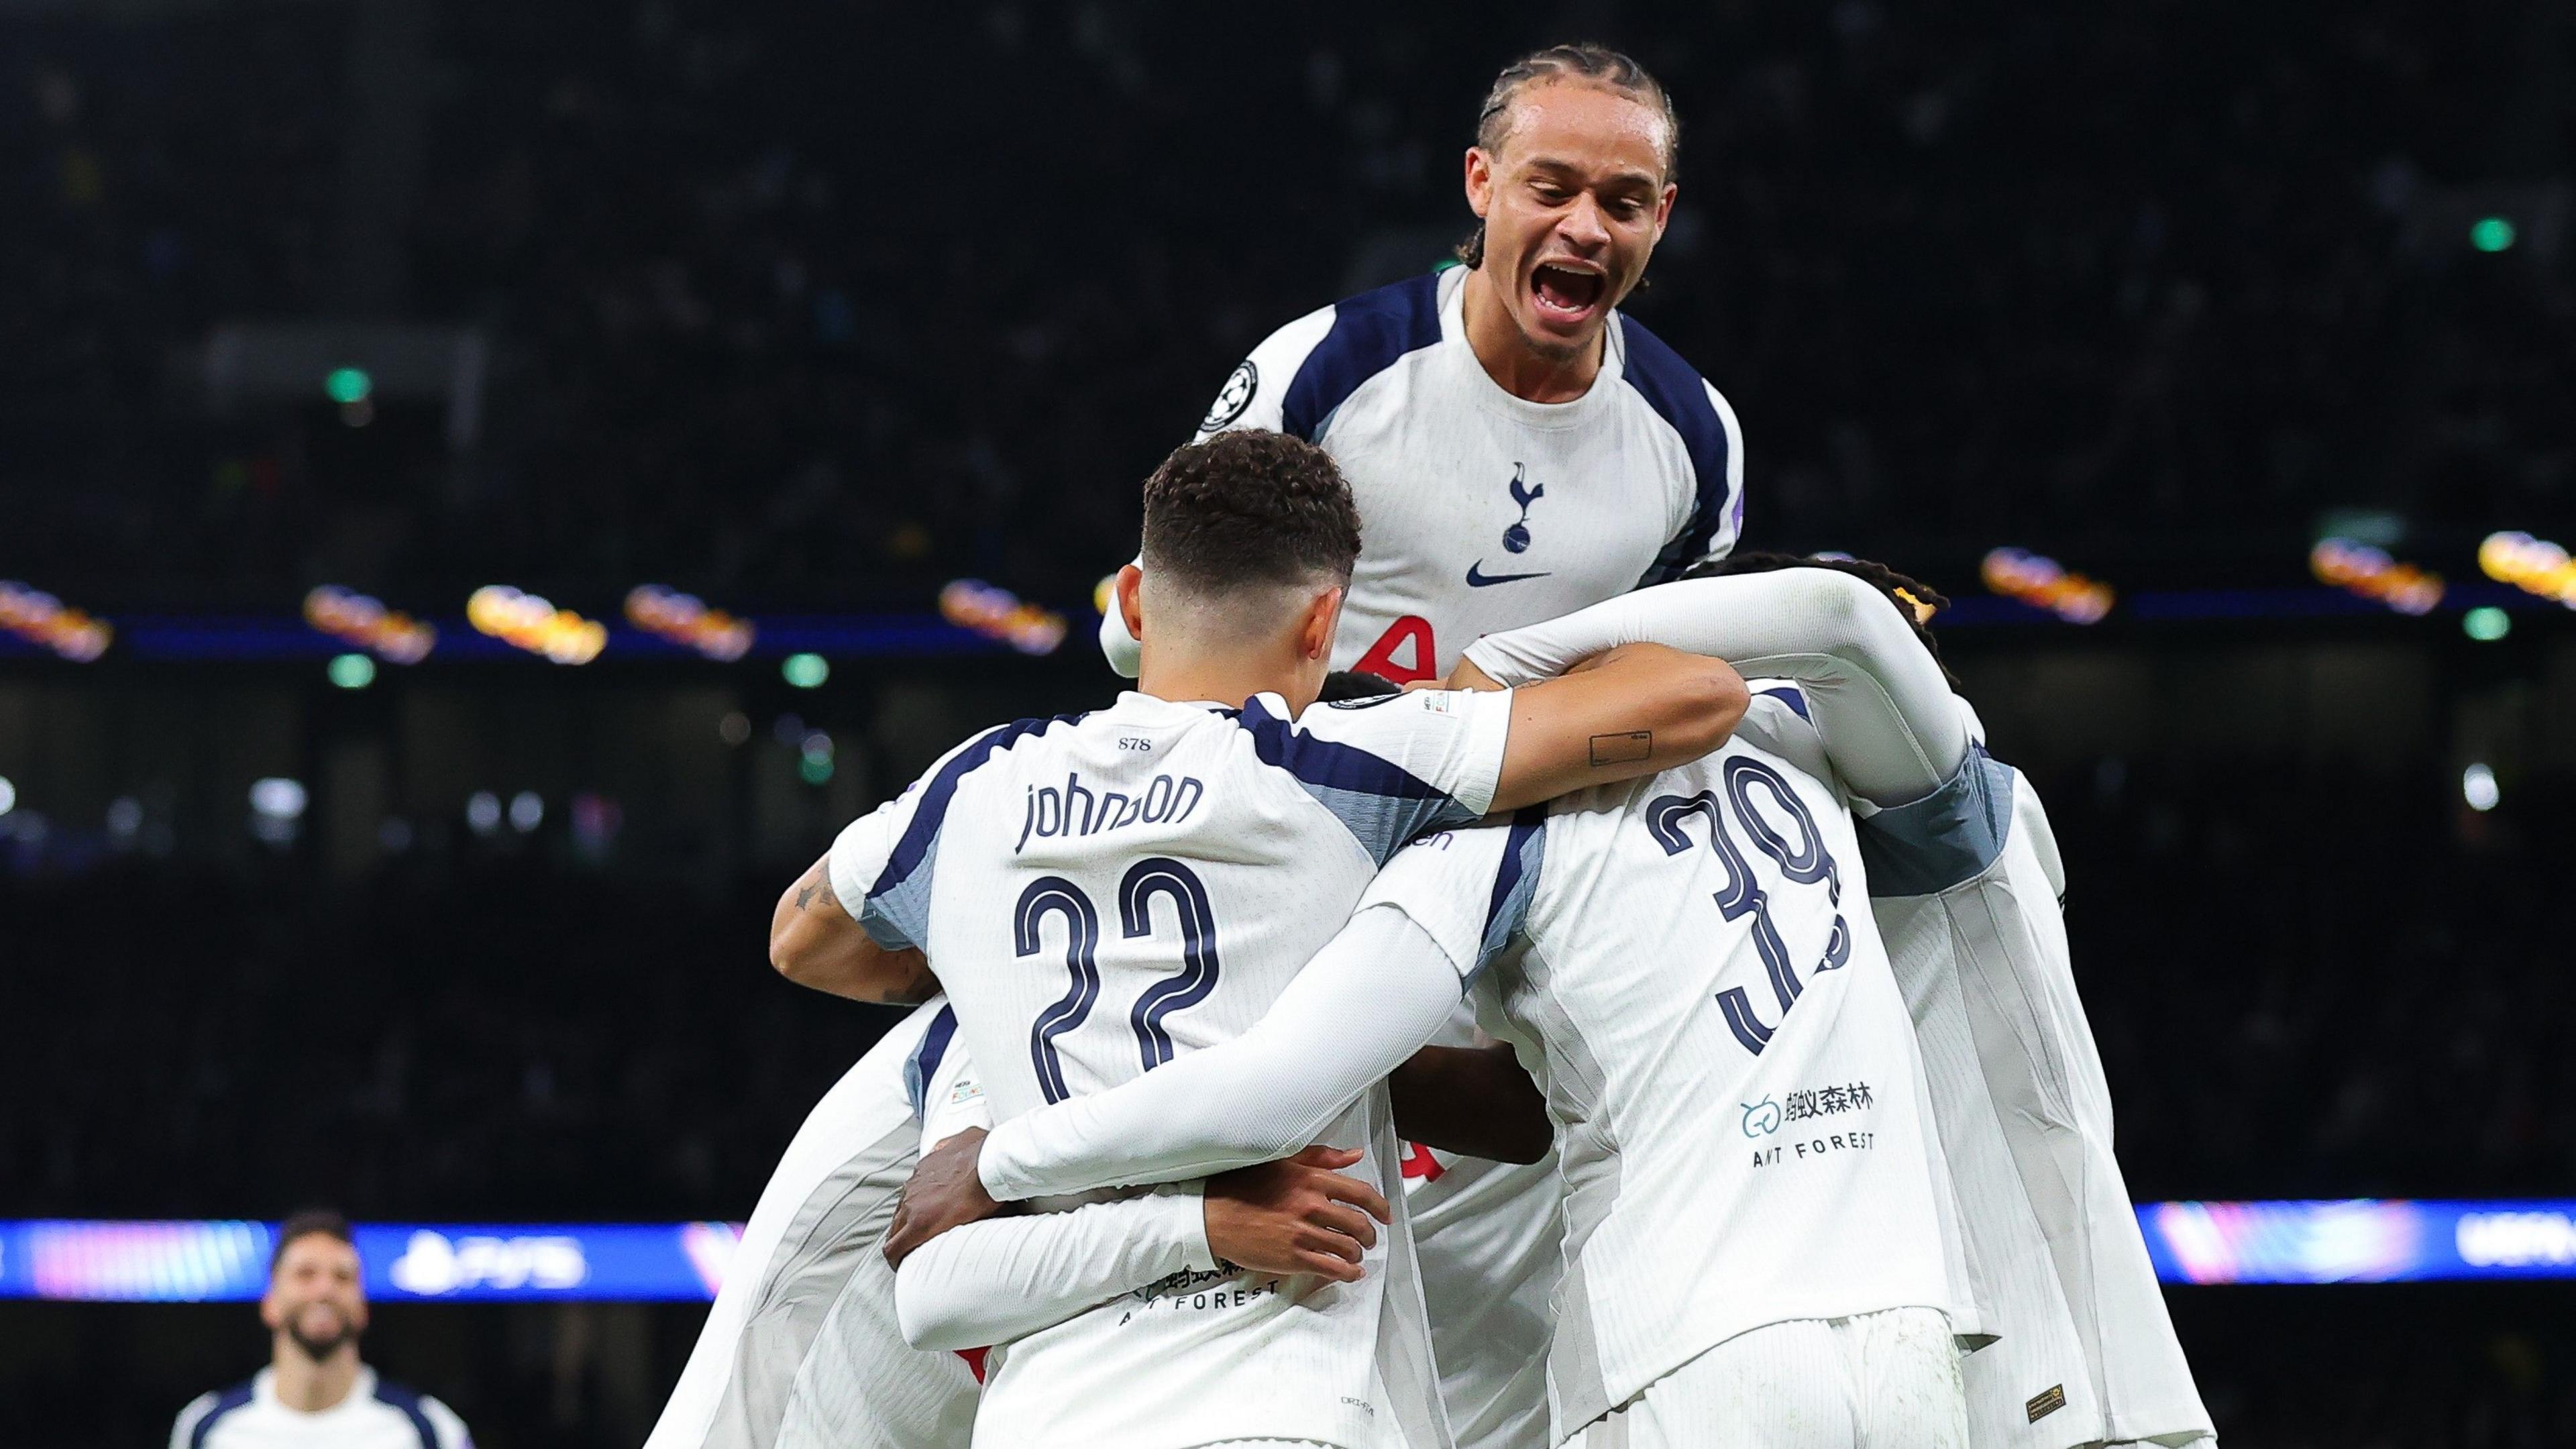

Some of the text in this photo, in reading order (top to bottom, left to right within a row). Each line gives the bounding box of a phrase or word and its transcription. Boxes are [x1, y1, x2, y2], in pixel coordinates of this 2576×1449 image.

[1118, 737, 1151, 751] 878
[1015, 772, 1203, 855] johnson
[1646, 755, 1851, 1057] 39
[1014, 857, 1220, 1105] 22
[1784, 1081, 1874, 1122] 蚂蚁森林
[1753, 1132, 1874, 1168] ANT FOREST
[1119, 1279, 1279, 1326] AT FOREST
